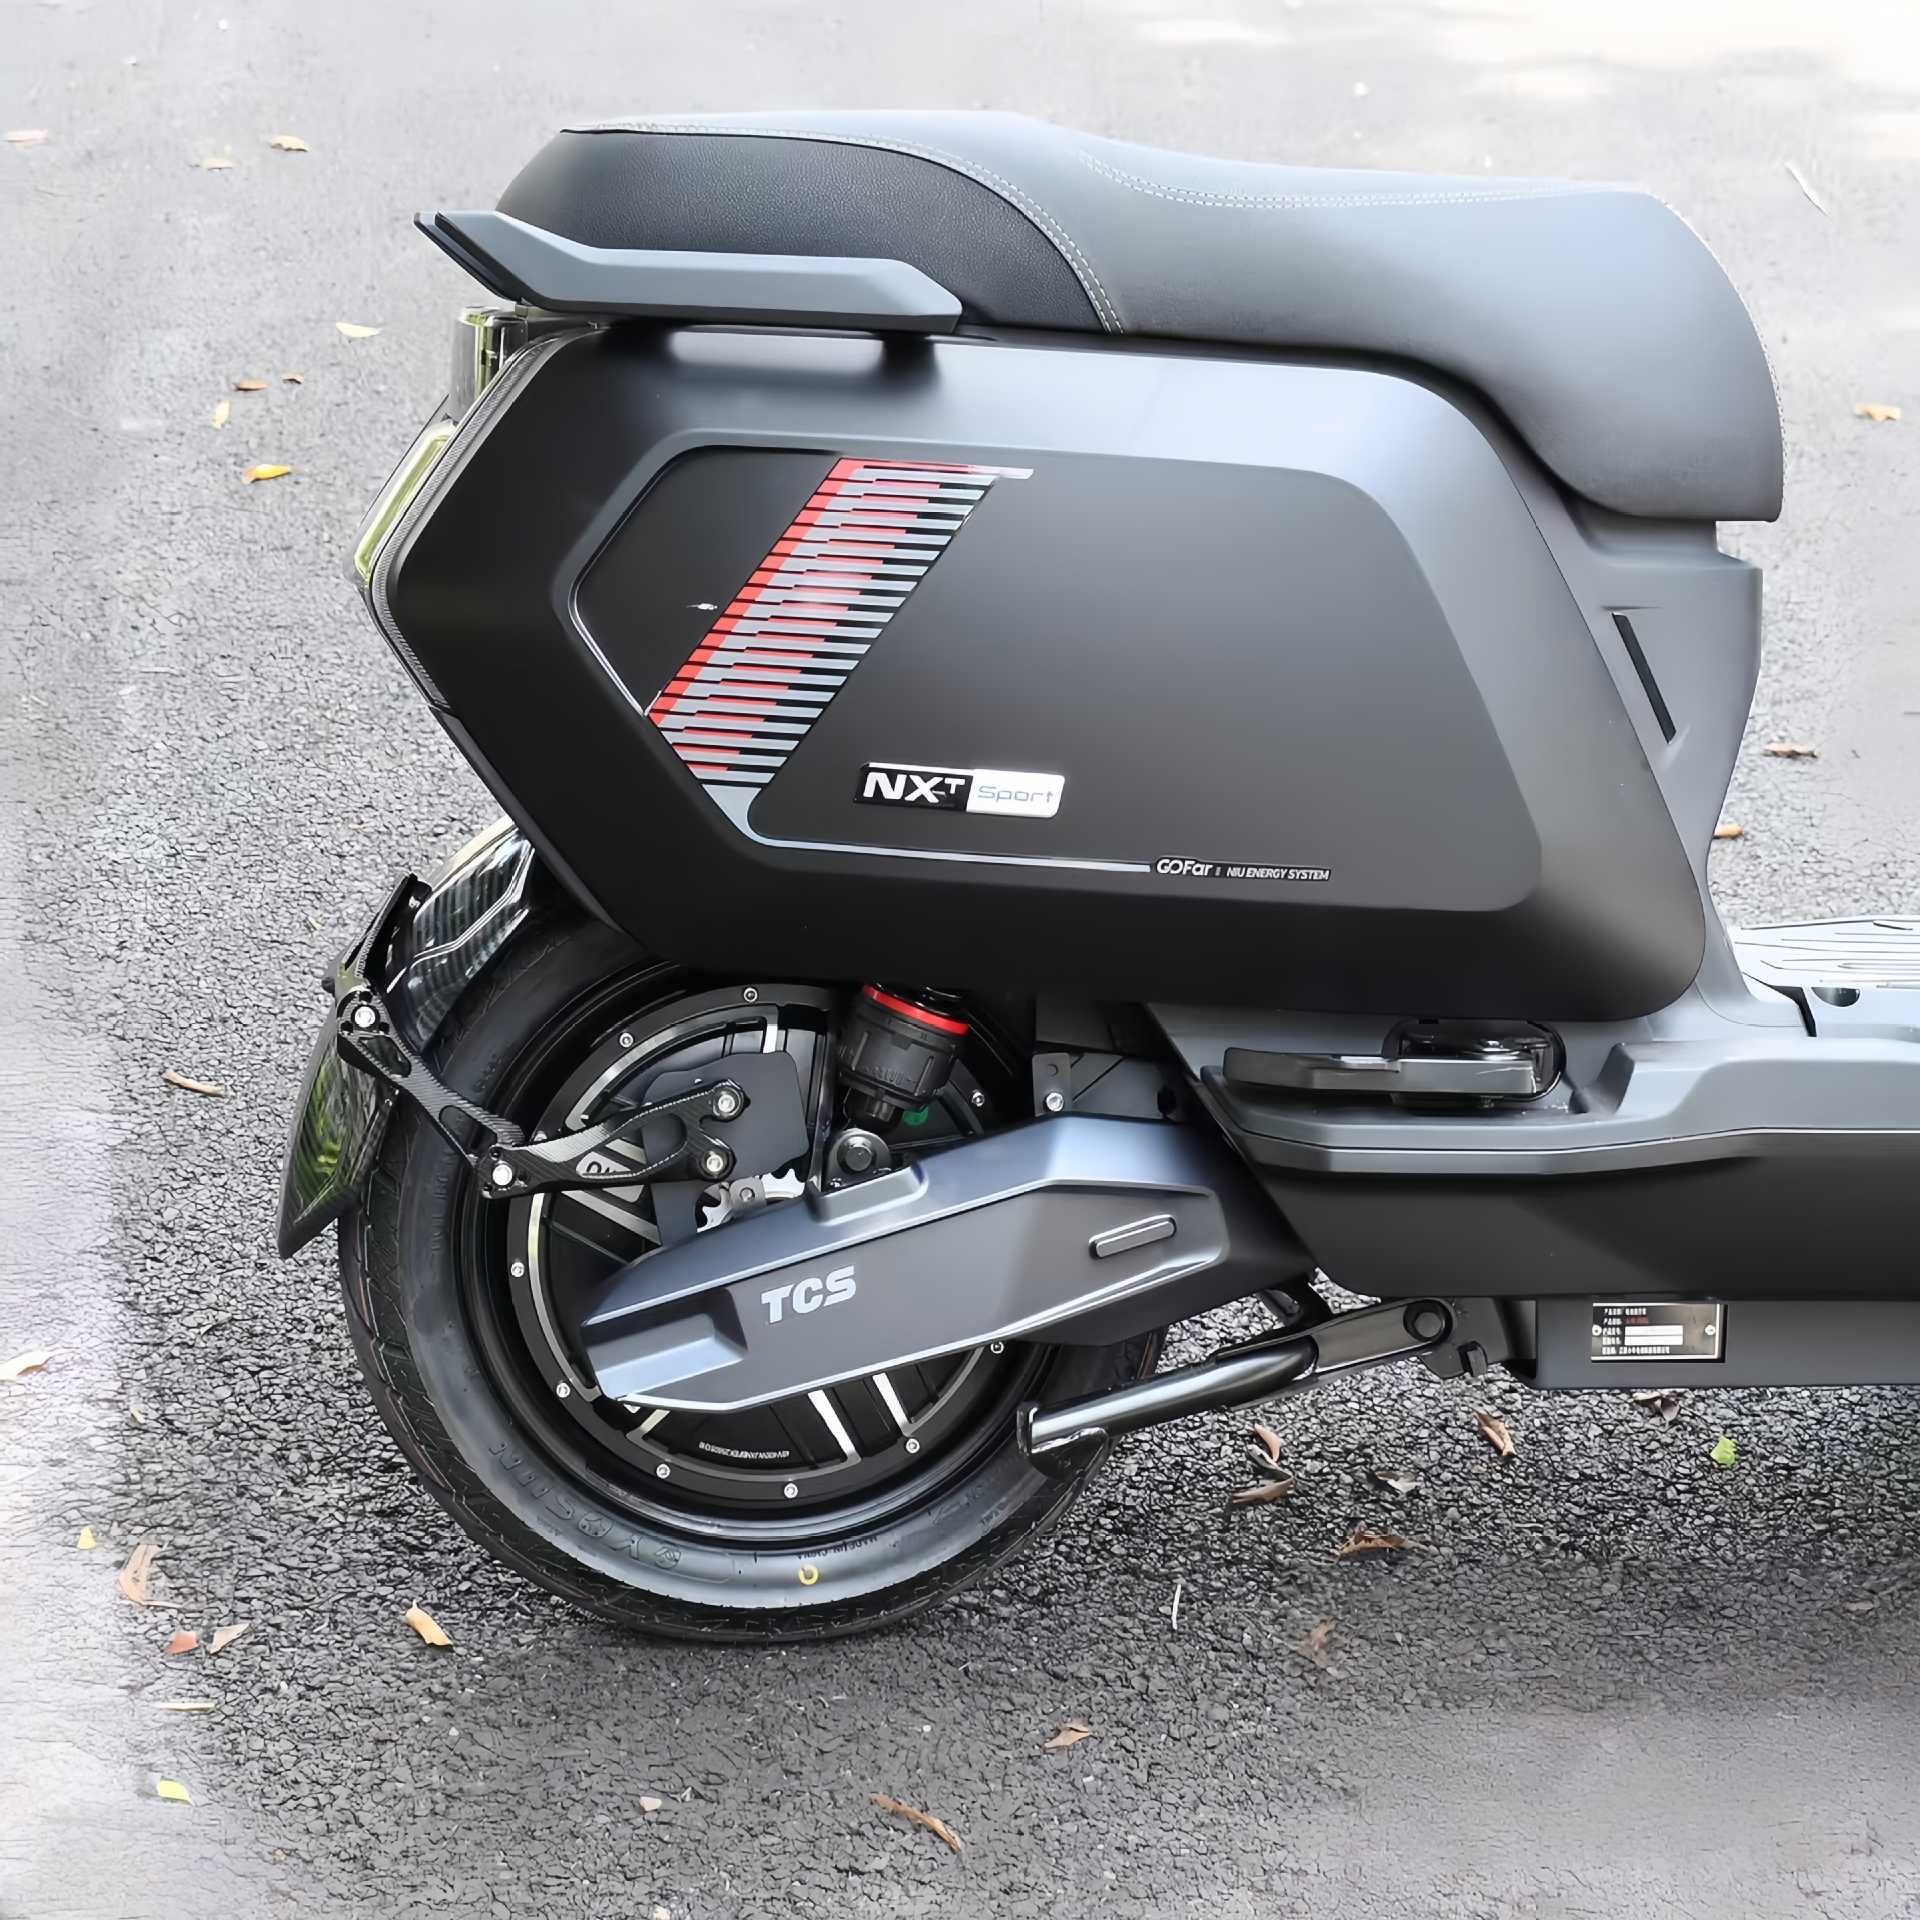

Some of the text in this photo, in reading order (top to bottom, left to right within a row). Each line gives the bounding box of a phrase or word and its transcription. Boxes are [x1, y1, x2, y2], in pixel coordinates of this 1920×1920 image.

[978, 785, 1054, 803] Sport
[1226, 866, 1246, 878] NIU
[1245, 867, 1288, 879] ENERGY
[1287, 869, 1330, 881] SYSTEM
[761, 1265, 857, 1324] TCS
